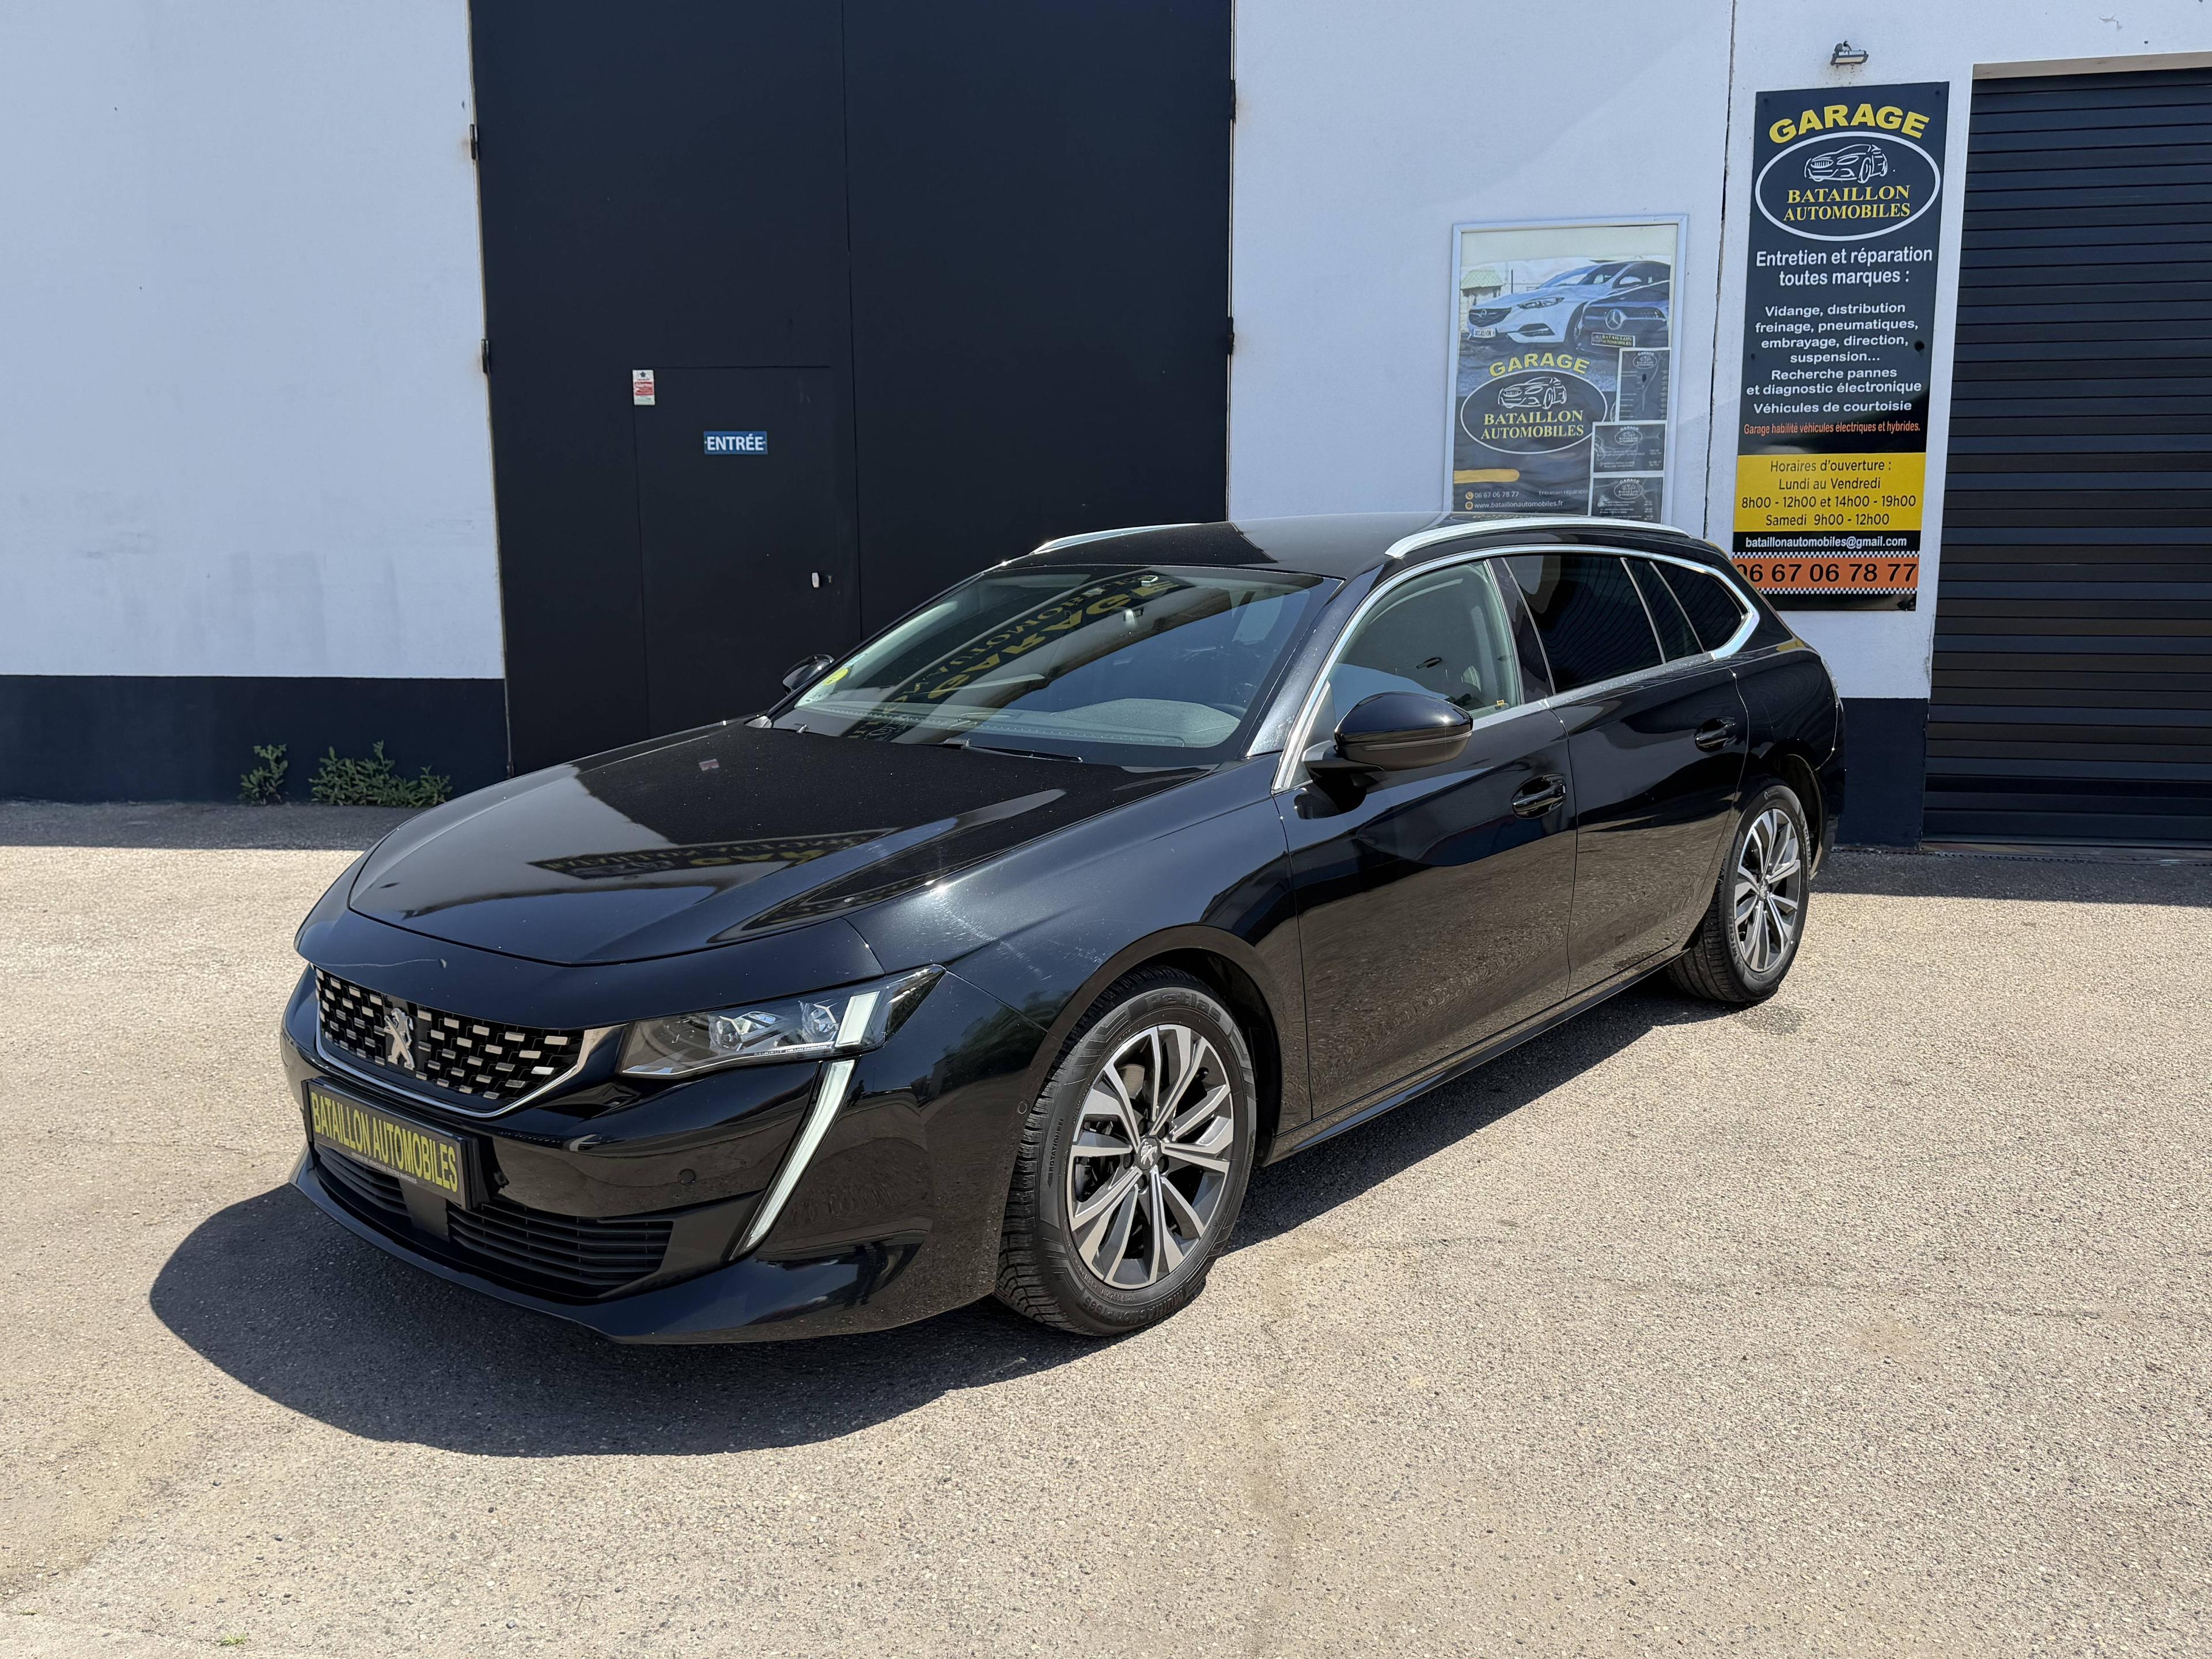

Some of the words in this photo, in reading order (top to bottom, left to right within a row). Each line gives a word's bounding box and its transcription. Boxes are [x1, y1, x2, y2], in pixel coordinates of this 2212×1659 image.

[1769, 104, 1929, 143] GARAGE
[1787, 185, 1910, 203] BATAILLON
[1783, 203, 1910, 221] AUTOMOBILES
[1756, 251, 1827, 267] Entretien
[1832, 249, 1846, 264] et
[1851, 247, 1932, 265] réparation
[1779, 270, 1827, 286] toutes
[1832, 269, 1900, 287] marques
[1765, 305, 1823, 318] Vidange,
[1828, 303, 1905, 315] distribution
[1755, 322, 1814, 334] freinage,
[1818, 319, 1918, 332] pneumatiques,
[1761, 336, 1839, 349] embrayage,
[1844, 335, 1908, 346] direction,
[1488, 353, 1590, 378] GARAGE
[1790, 353, 1880, 364] suspension...
[1771, 369, 1843, 380] Recherche
[1847, 368, 1897, 380] pannes
[1747, 385, 1760, 395] et
[1763, 384, 1833, 396] diagnostic
[1837, 381, 1922, 395] électronique
[1754, 402, 1819, 414] Véhicules
[1823, 402, 1839, 412] de
[1843, 400, 1911, 412] courtoisie
[1483, 410, 1583, 426] BATAILLON
[1480, 424, 1584, 440] AUTOMOBILES
[1744, 423, 1770, 436] Garage
[1771, 423, 1798, 434] habilité
[1800, 422, 1834, 433] véhicules
[1836, 422, 1876, 434] électriques
[1878, 423, 1885, 432] et
[1887, 421, 1920, 433] hybrides.
[707, 433, 764, 450] ENTRÉE
[1770, 460, 1816, 472] Horaires
[1820, 460, 1884, 472] d'ouverture
[1779, 478, 1809, 490] Lundi
[1813, 480, 1826, 489] au
[1831, 478, 1880, 489] Vendredi
[1474, 501, 1563, 509] www.bataillonautomobiles.fr
[1742, 497, 1771, 508] 8h00
[1783, 496, 1816, 507] 12h00
[1820, 497, 1831, 507] et
[1835, 496, 1869, 507] 14h00
[1881, 495, 1916, 506] 19h00
[1766, 515, 1806, 526] Samedi
[1814, 514, 1843, 525] 9h00
[1855, 514, 1889, 525] 12h00
[1745, 536, 1907, 548] bataillonautomobiles@gmail.com
[1772, 564, 1802, 582] 67
[1809, 564, 1839, 582] 06
[1850, 564, 1877, 581] 78
[1888, 563, 1917, 580] 77
[1145, 992, 1221, 1022] Petlas
[310, 1092, 371, 1156] BATAILLON
[373, 1117, 458, 1193] AUTOMOBILES
